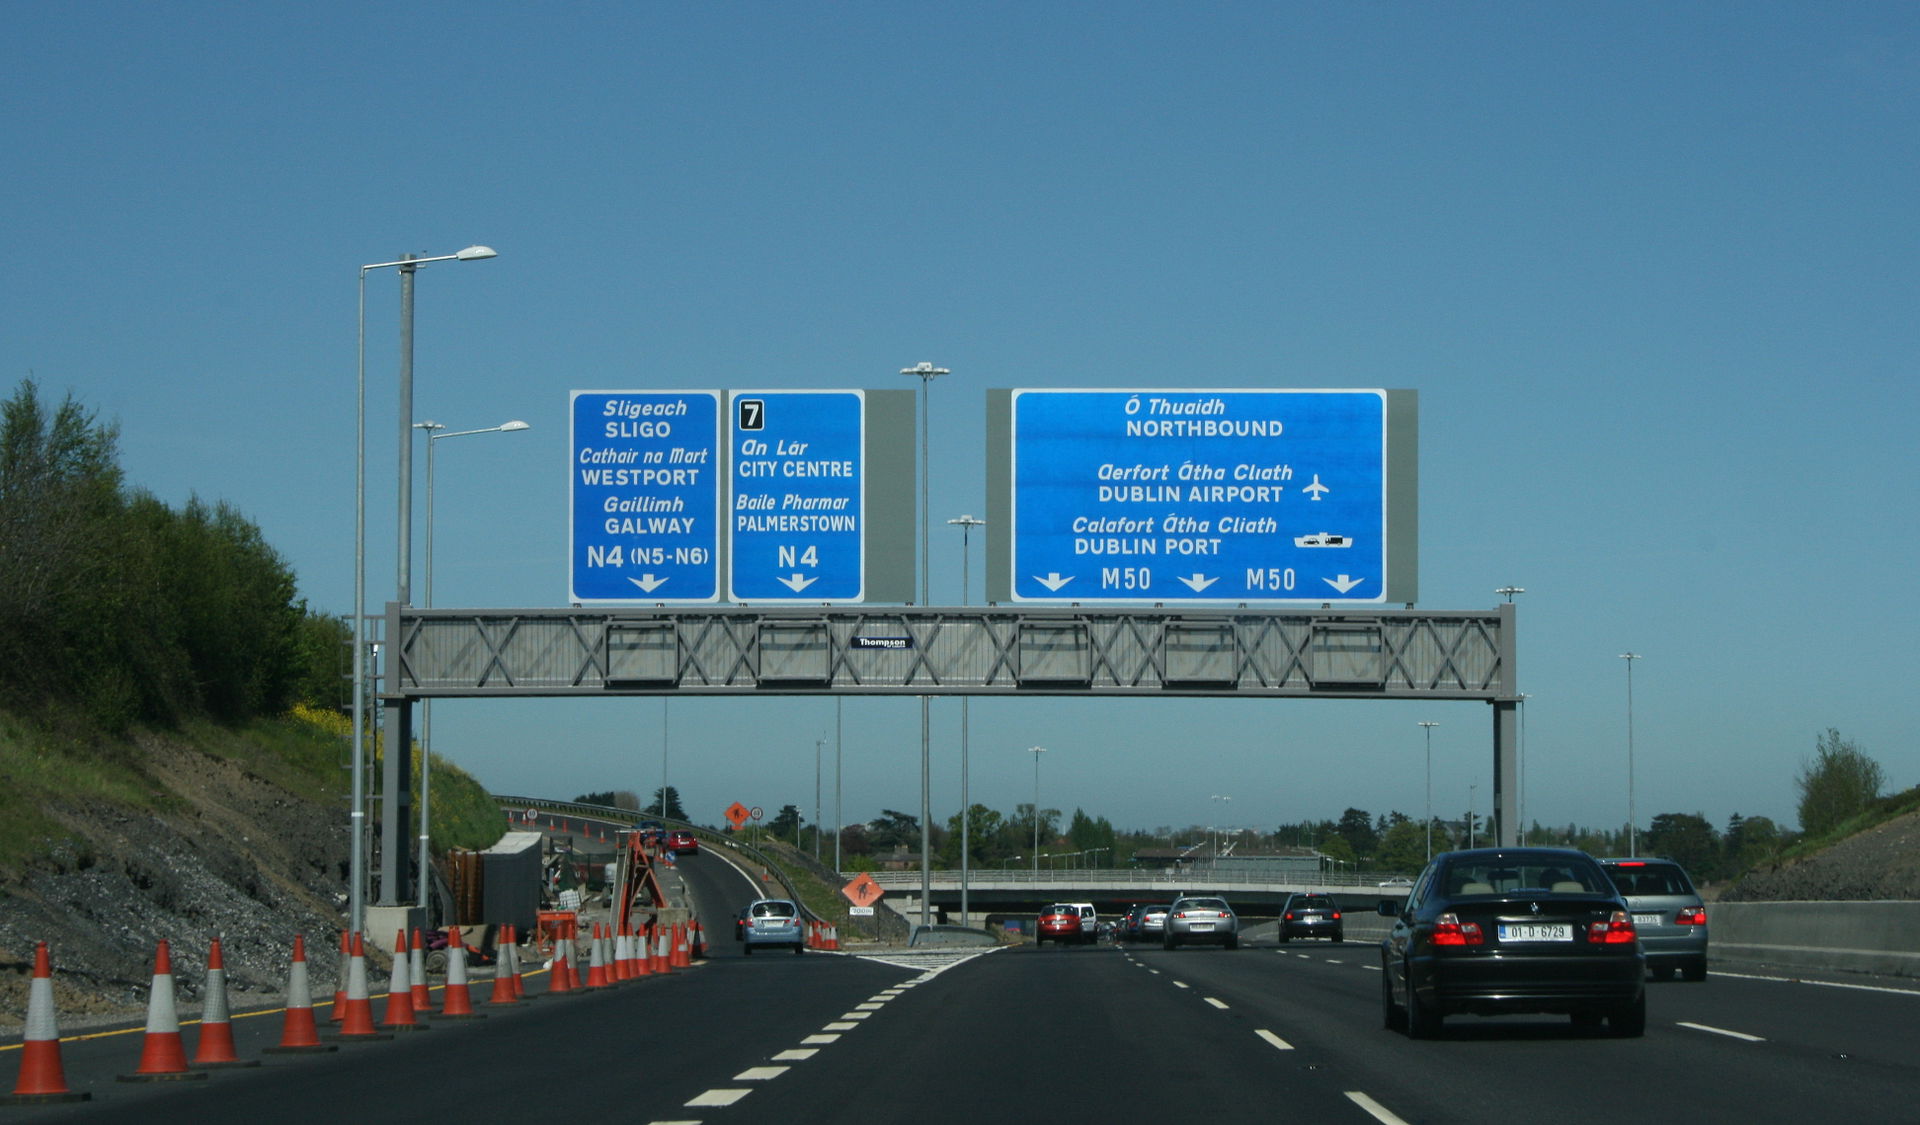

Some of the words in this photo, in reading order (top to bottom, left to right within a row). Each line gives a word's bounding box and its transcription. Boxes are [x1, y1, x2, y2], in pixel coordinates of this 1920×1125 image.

[603, 400, 687, 417] Sligeach
[1125, 395, 1141, 415] Ó
[1149, 399, 1225, 415] Thuaidh
[744, 404, 760, 427] 7
[605, 421, 671, 438] SLIGO
[1126, 420, 1283, 437] NORTHBOUND
[579, 447, 639, 464] Cathair
[643, 451, 664, 464] na
[669, 447, 708, 464] Mart
[741, 439, 768, 456] An
[776, 439, 809, 456] Lár
[739, 460, 778, 477] CITY
[782, 460, 853, 477] CENTRE
[1097, 463, 1170, 481] Aerfort
[1178, 460, 1226, 481] Átha
[581, 469, 699, 486] WESTPORT
[736, 493, 776, 510] Baile
[782, 493, 850, 510] Pharmar
[1099, 486, 1181, 502] DUBLIN
[1188, 486, 1284, 502] AIRPORT
[603, 496, 684, 513] Gaillimh
[605, 517, 695, 534] GALWAY
[738, 515, 855, 532] PALMERSTOWN
[1072, 516, 1154, 533] Calafort
[1162, 512, 1211, 533] Átha
[1218, 516, 1277, 533] Cliath
[1075, 538, 1156, 555] DUBLIN
[1165, 538, 1222, 555] PORT
[587, 545, 624, 568] N4
[630, 547, 709, 565] (N5-N6)
[1102, 567, 1151, 590] M50
[1247, 567, 1295, 590] M50
[860, 638, 906, 647] Thompson
